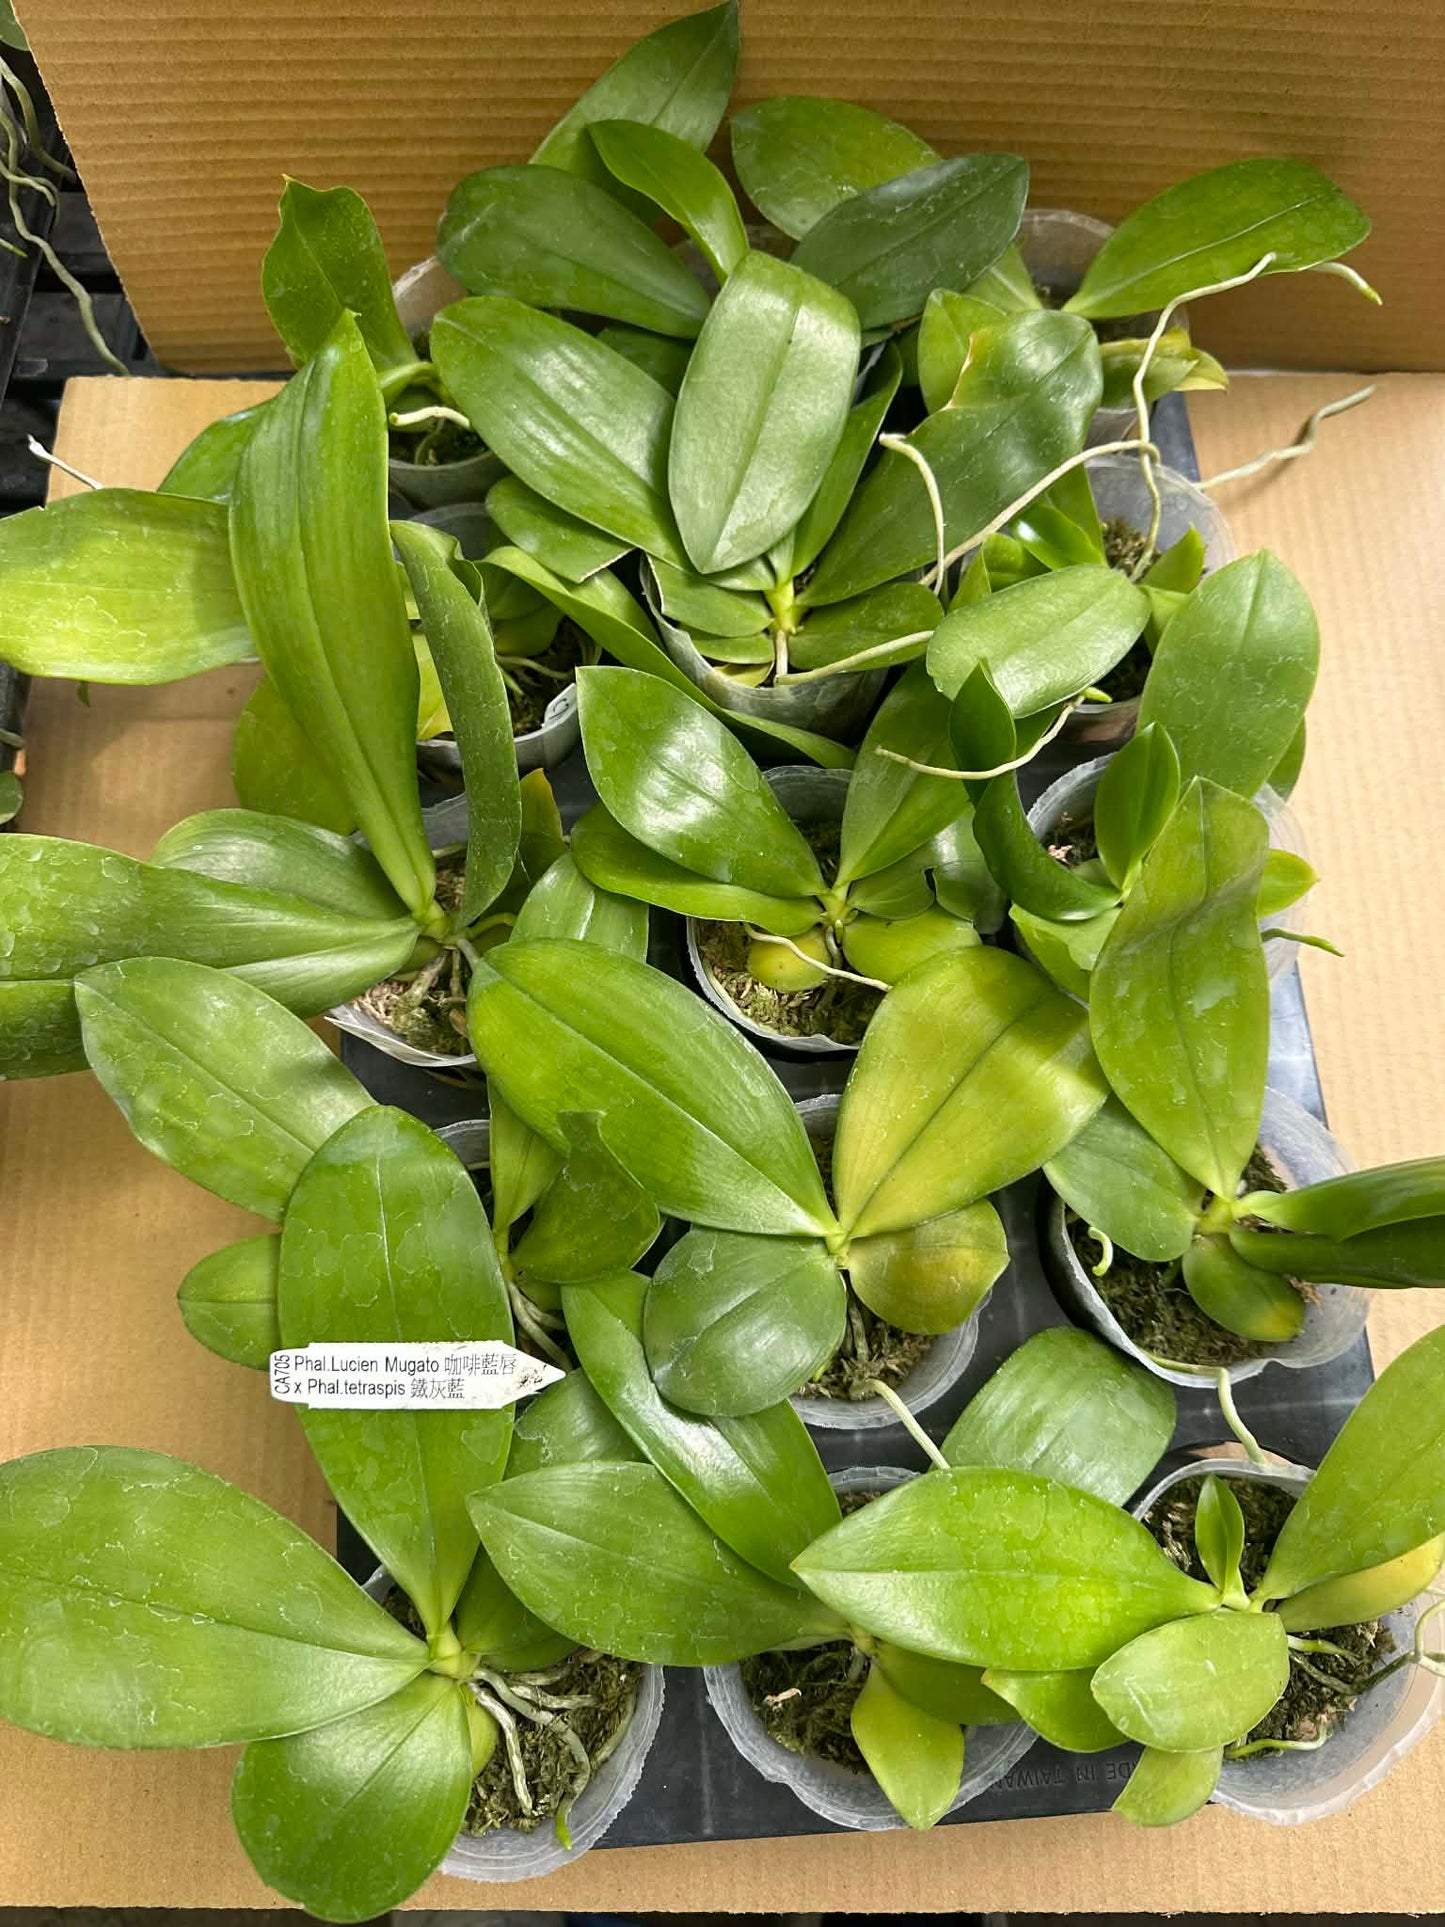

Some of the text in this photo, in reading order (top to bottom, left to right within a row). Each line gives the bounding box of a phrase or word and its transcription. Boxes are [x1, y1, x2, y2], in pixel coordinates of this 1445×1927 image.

[274, 1354, 291, 1394] CA705
[294, 1352, 517, 1376] Phal.Lucien Mugato 咖啡藍唇
[294, 1382, 302, 1394] x
[307, 1378, 406, 1399] Phal.tetraspis
[1075, 1762, 1096, 1781] IN
